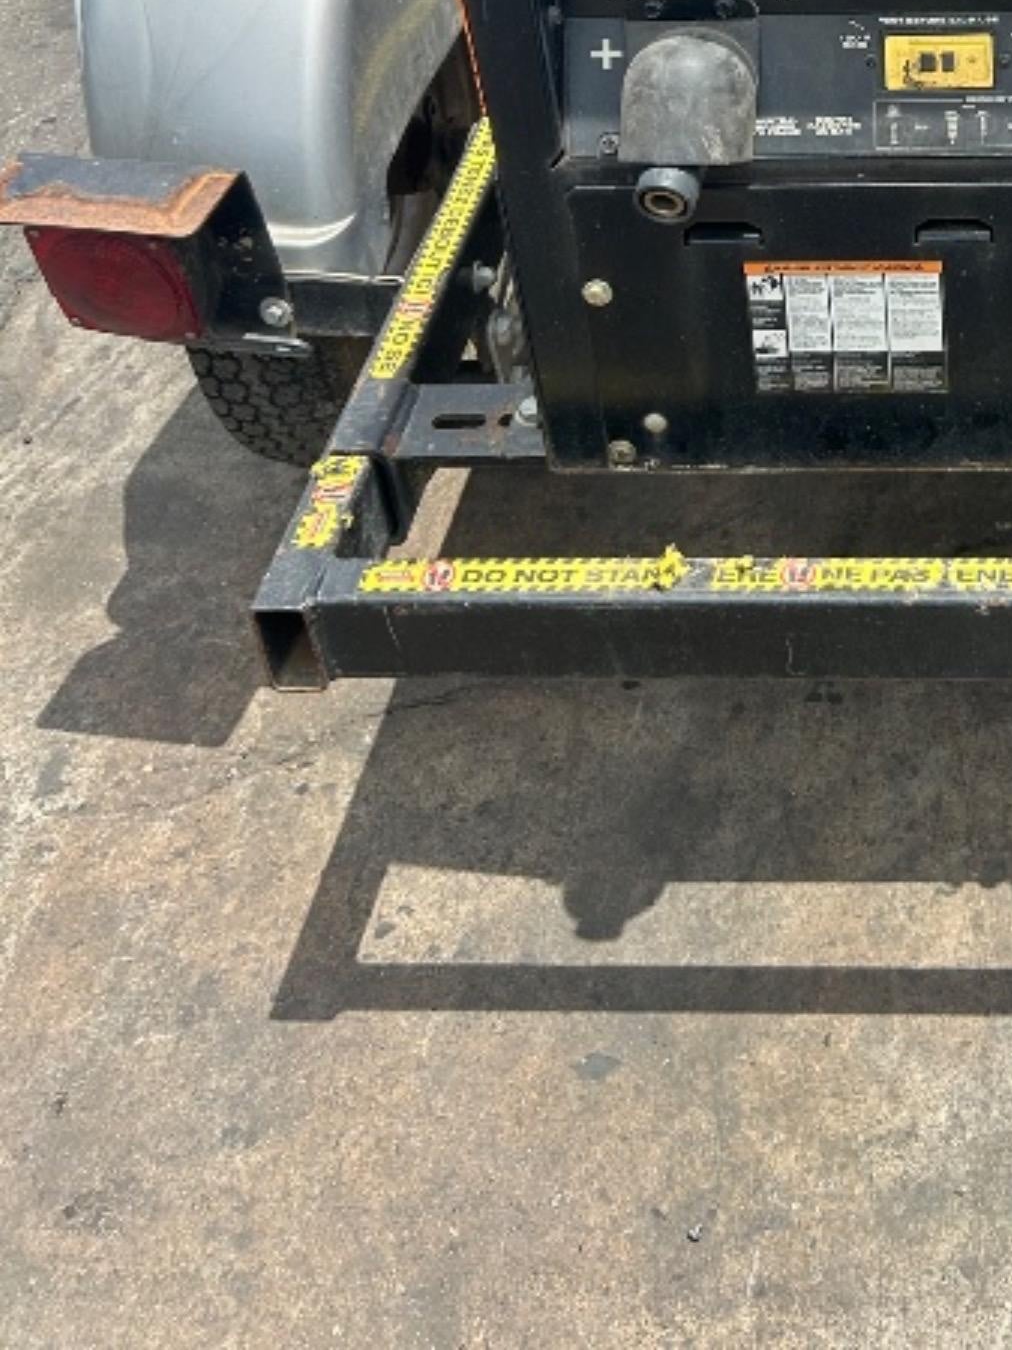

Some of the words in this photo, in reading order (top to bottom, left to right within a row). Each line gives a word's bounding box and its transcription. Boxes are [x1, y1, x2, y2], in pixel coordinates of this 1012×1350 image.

[461, 569, 506, 584] DO
[514, 569, 578, 584] NOT
[870, 568, 930, 584] PAS
